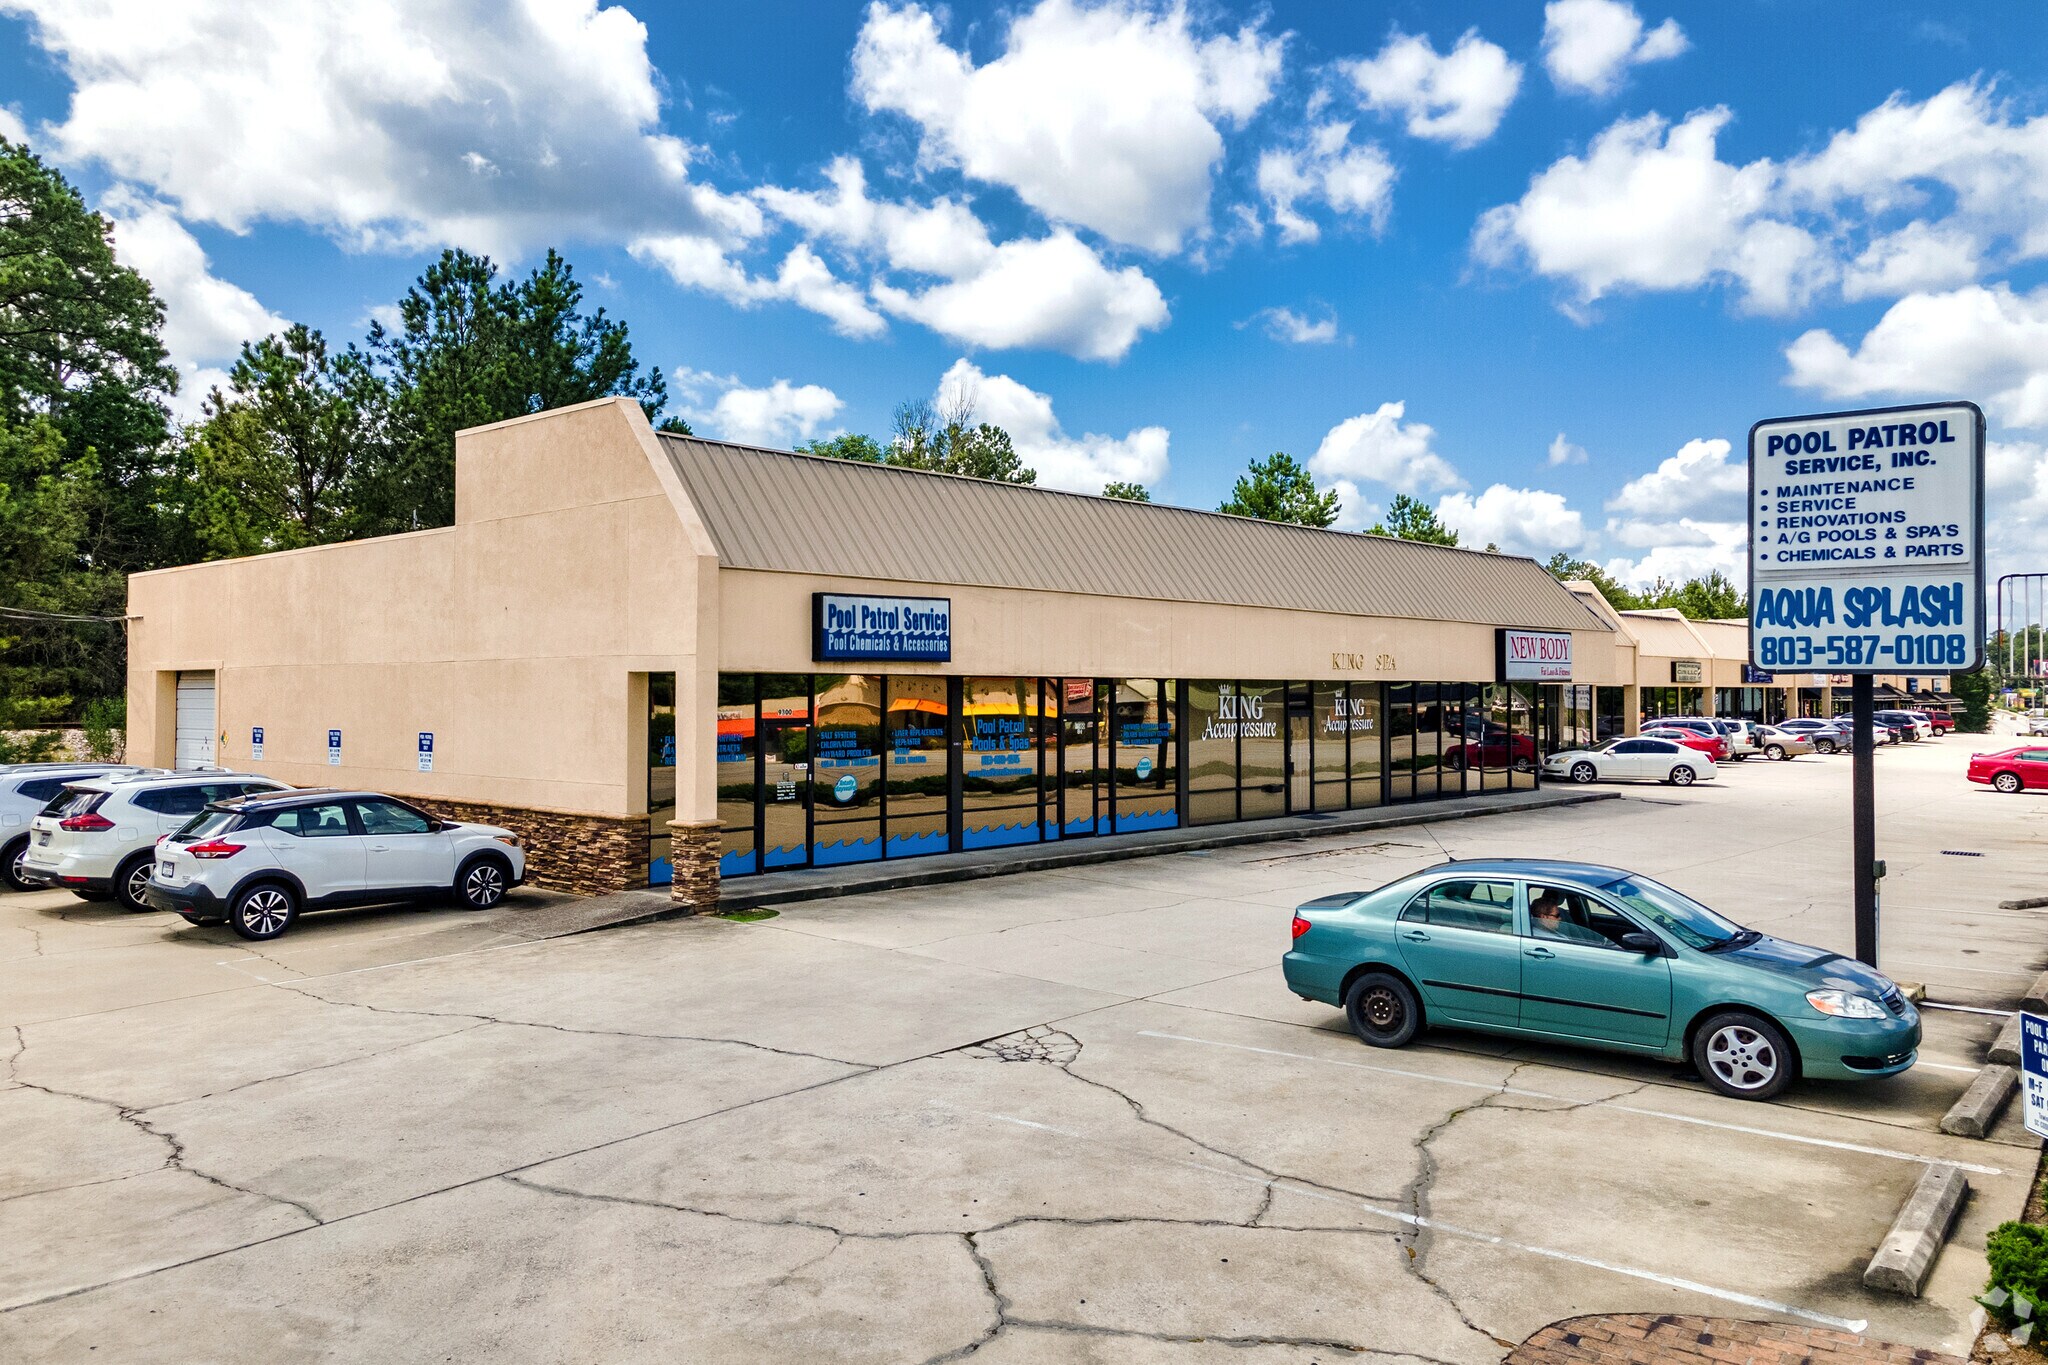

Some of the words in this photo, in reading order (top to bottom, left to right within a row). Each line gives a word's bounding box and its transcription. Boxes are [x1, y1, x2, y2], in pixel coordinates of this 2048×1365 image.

[1768, 431, 1836, 457] POOL
[1848, 420, 1955, 451] PATROL
[1785, 455, 1881, 475] SERVICE,
[1891, 450, 1936, 468] INC.
[1777, 477, 1915, 498] MAINTENANCE
[1777, 497, 1856, 513] SERVICE
[1777, 511, 1906, 529] RENOVATIONS
[1777, 532, 1811, 545] A/G
[1818, 528, 1877, 543] POOLS
[1885, 527, 1897, 539] &
[1906, 524, 1959, 539] SPA'S
[1777, 547, 1876, 562] CHEMICALS
[1884, 546, 1897, 558] &
[1905, 543, 1964, 557] PARTS
[1755, 586, 1835, 629] AQUA
[1843, 582, 1963, 628] SPLASH
[828, 604, 856, 629] Pool
[861, 605, 899, 630] Patrol
[903, 607, 948, 631] Service
[828, 634, 847, 651] Pool
[850, 634, 890, 651] Chemicals
[893, 636, 900, 651] &
[902, 636, 948, 652] Accessories
[1510, 636, 1538, 659] NEW
[1539, 637, 1570, 660] BODY
[1761, 634, 1966, 665] 803-587-0108
[1332, 653, 1364, 670] KING
[1375, 654, 1397, 670] SPA
[1218, 695, 1264, 720] KING
[1334, 698, 1365, 716] KING
[821, 731, 833, 739] SALT
[834, 730, 857, 739] SYSTEMS
[977, 718, 996, 734] Pool
[999, 718, 1025, 733] Patrol
[1201, 716, 1277, 743] Accupressure
[972, 735, 996, 751] Pools
[1000, 735, 1006, 750] &
[1009, 734, 1029, 753] Spas
[2025, 1020, 2044, 1038] POOL
[2028, 1077, 2043, 1093] M-F
[2031, 1093, 2044, 1109] SAT
